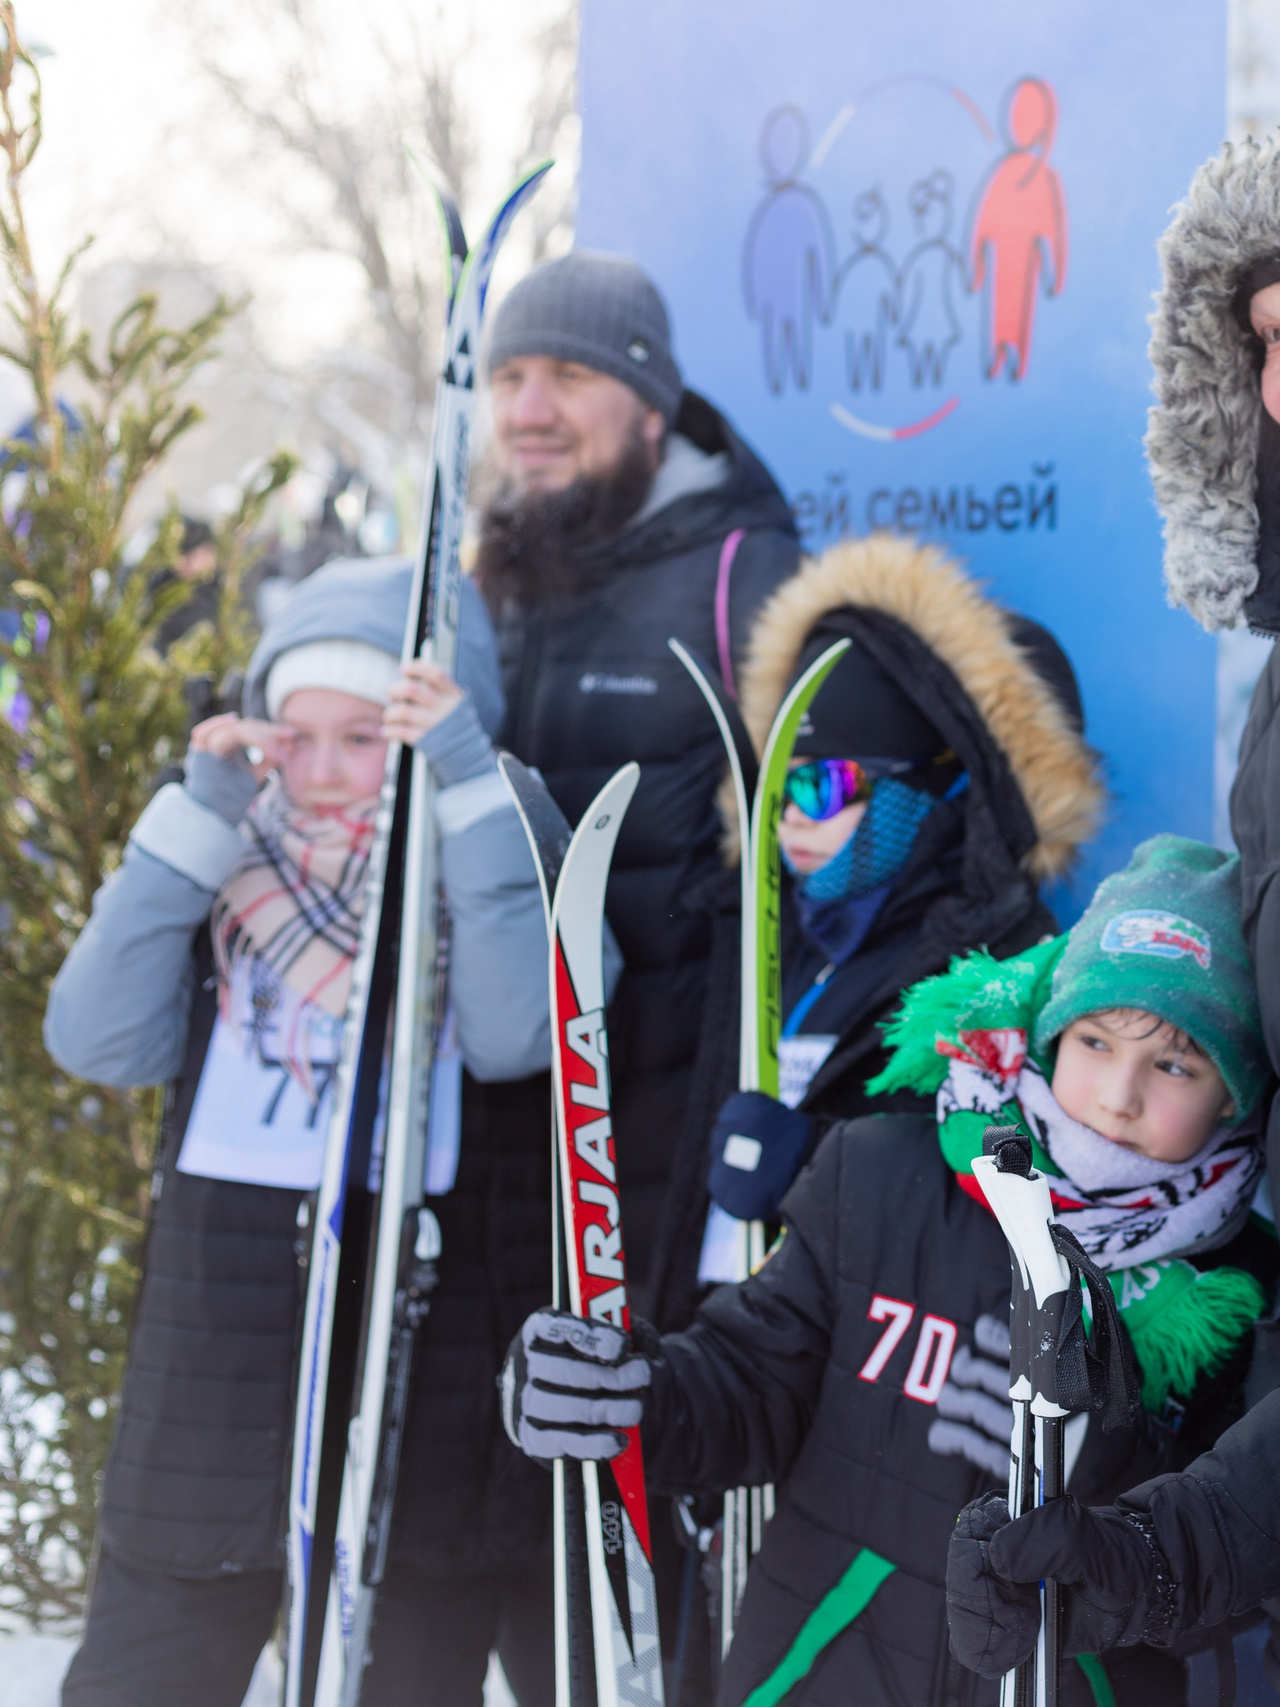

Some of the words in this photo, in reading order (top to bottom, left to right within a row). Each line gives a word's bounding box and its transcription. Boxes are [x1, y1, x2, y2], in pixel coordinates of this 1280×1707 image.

[865, 460, 1057, 533] семьей
[565, 1006, 627, 1338] ARJALA
[857, 1293, 958, 1406] 70
[601, 1500, 623, 1555] 140
